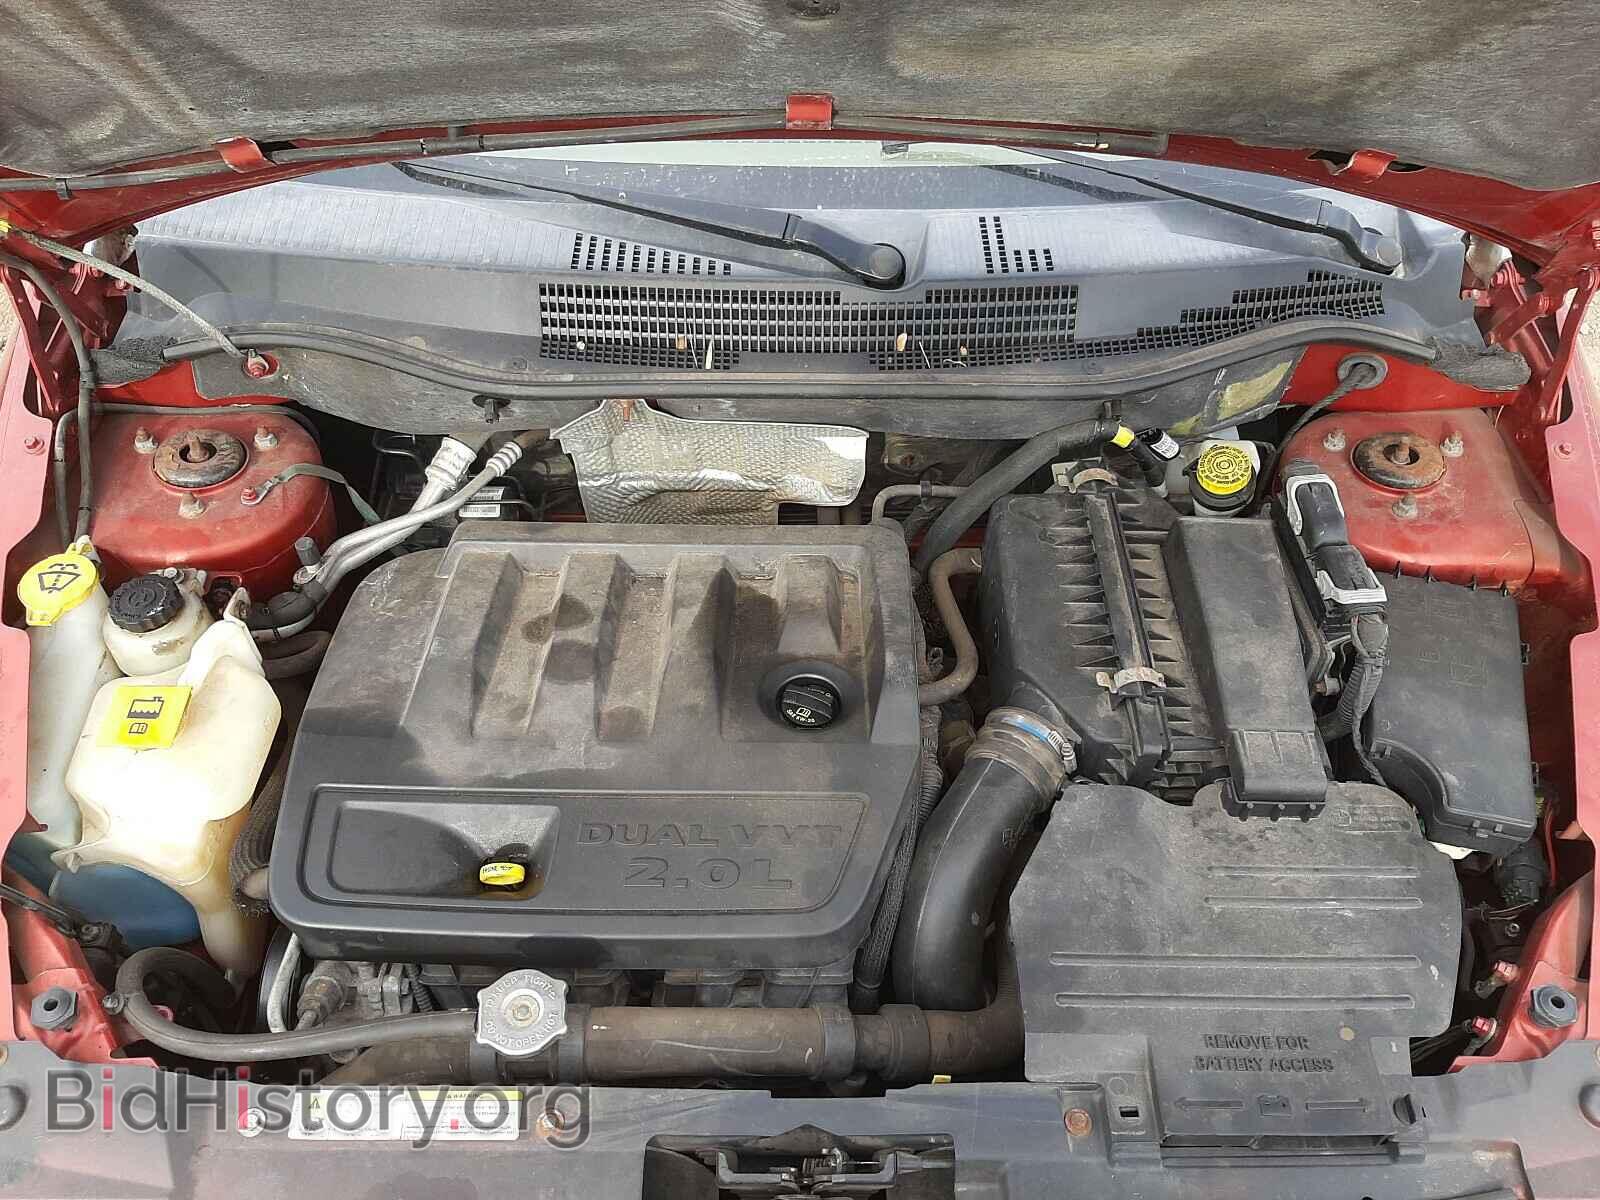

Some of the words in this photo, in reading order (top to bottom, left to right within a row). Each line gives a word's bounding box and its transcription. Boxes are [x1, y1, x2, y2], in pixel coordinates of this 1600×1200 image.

[576, 823, 720, 848] DUAL
[731, 824, 842, 848] VVT
[624, 857, 793, 889] 2.0L
[1203, 1033, 1273, 1049] REMOVE
[1275, 1035, 1311, 1050] FOR
[1194, 1055, 1264, 1072] BATTERY
[1269, 1056, 1335, 1073] ACCESS
